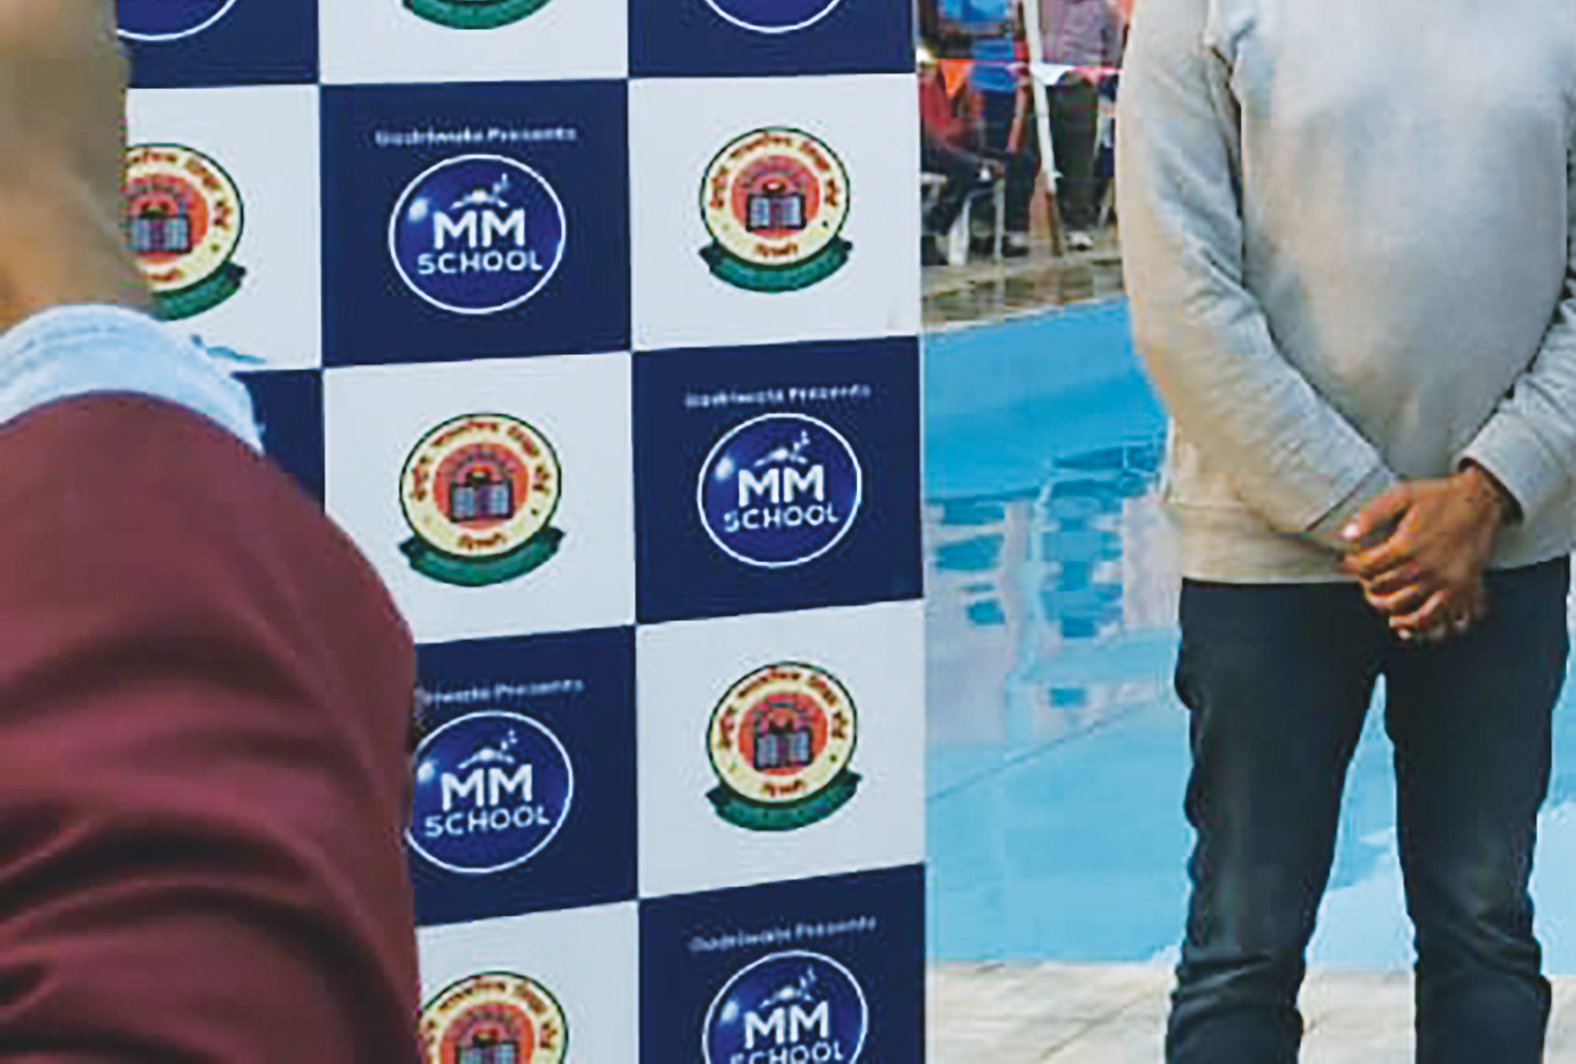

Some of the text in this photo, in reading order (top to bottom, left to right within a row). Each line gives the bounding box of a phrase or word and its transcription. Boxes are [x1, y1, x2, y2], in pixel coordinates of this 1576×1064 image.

[433, 208, 525, 250] MM
[417, 249, 543, 275] SCHOOL
[738, 464, 824, 508] MM
[723, 503, 841, 533] SCHOOL
[441, 764, 532, 813] MM
[425, 805, 551, 838] SCHOOL
[744, 1000, 829, 1050] MM
